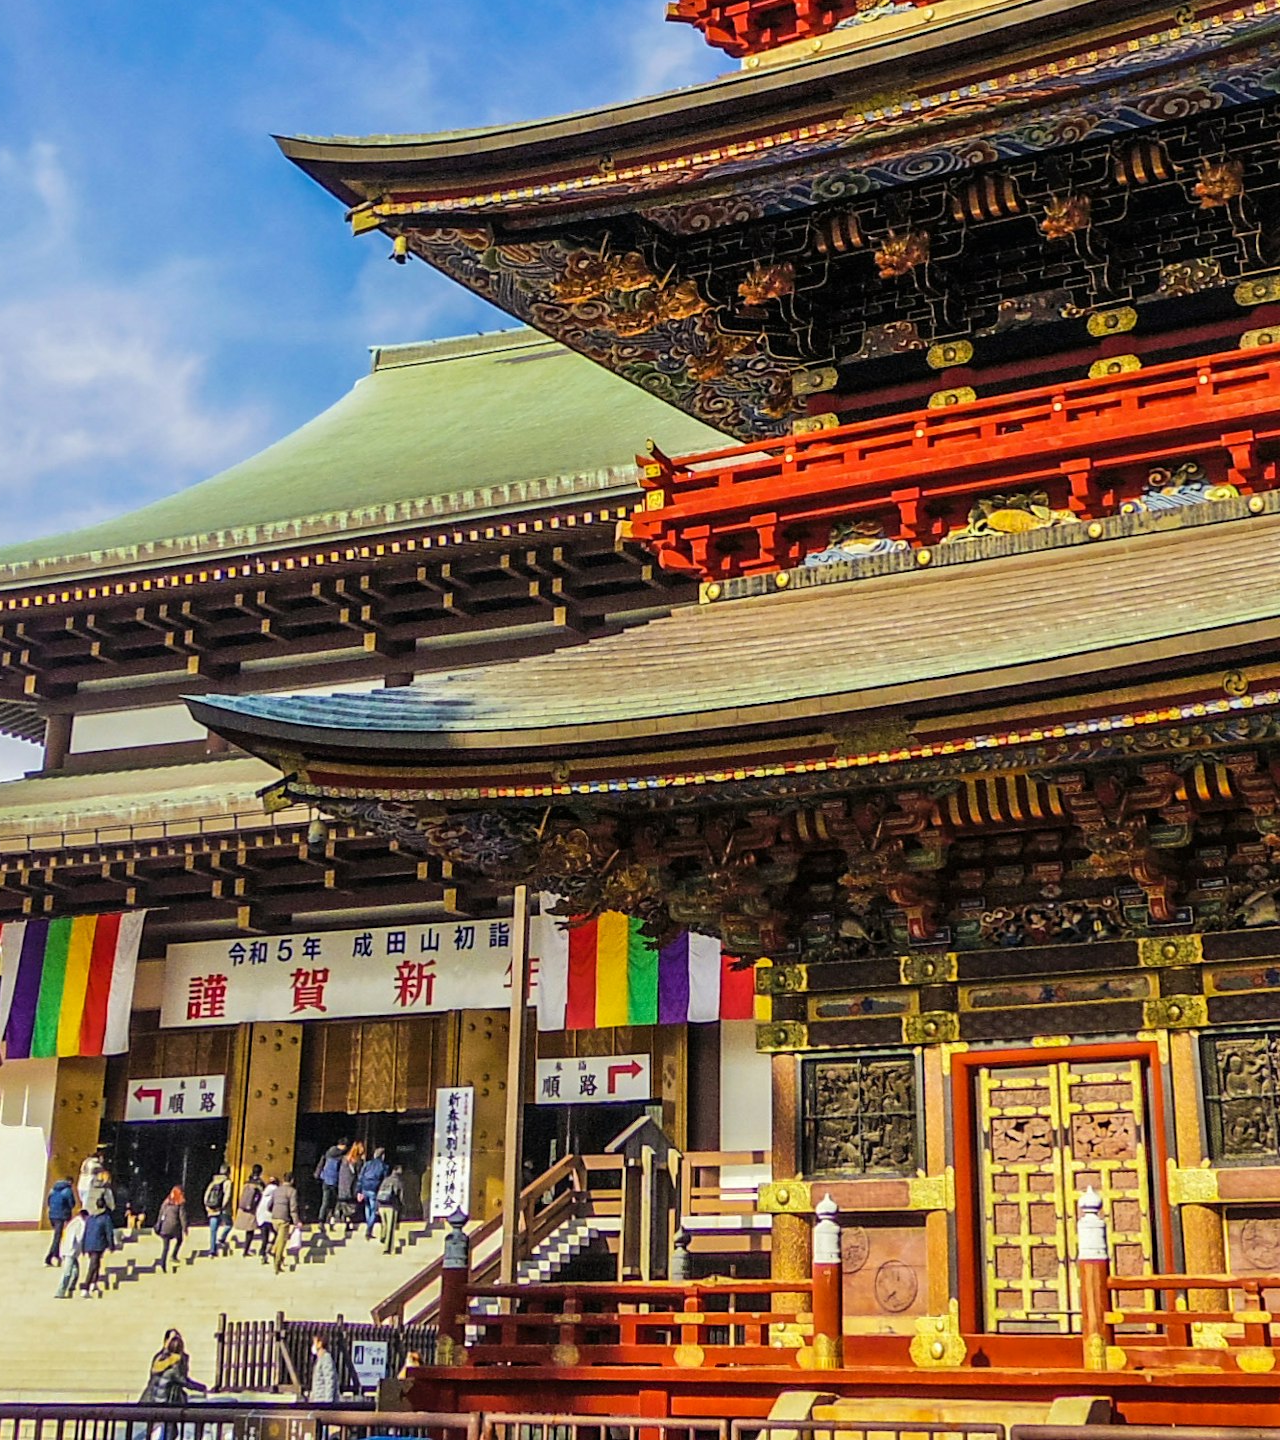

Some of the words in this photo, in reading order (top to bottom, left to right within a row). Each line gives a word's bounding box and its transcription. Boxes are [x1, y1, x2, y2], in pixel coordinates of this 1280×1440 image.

[228, 936, 322, 967] 令和5年
[352, 921, 510, 958] 成田山初詣
[542, 1074, 598, 1098] 順路
[168, 1092, 216, 1114] 順路
